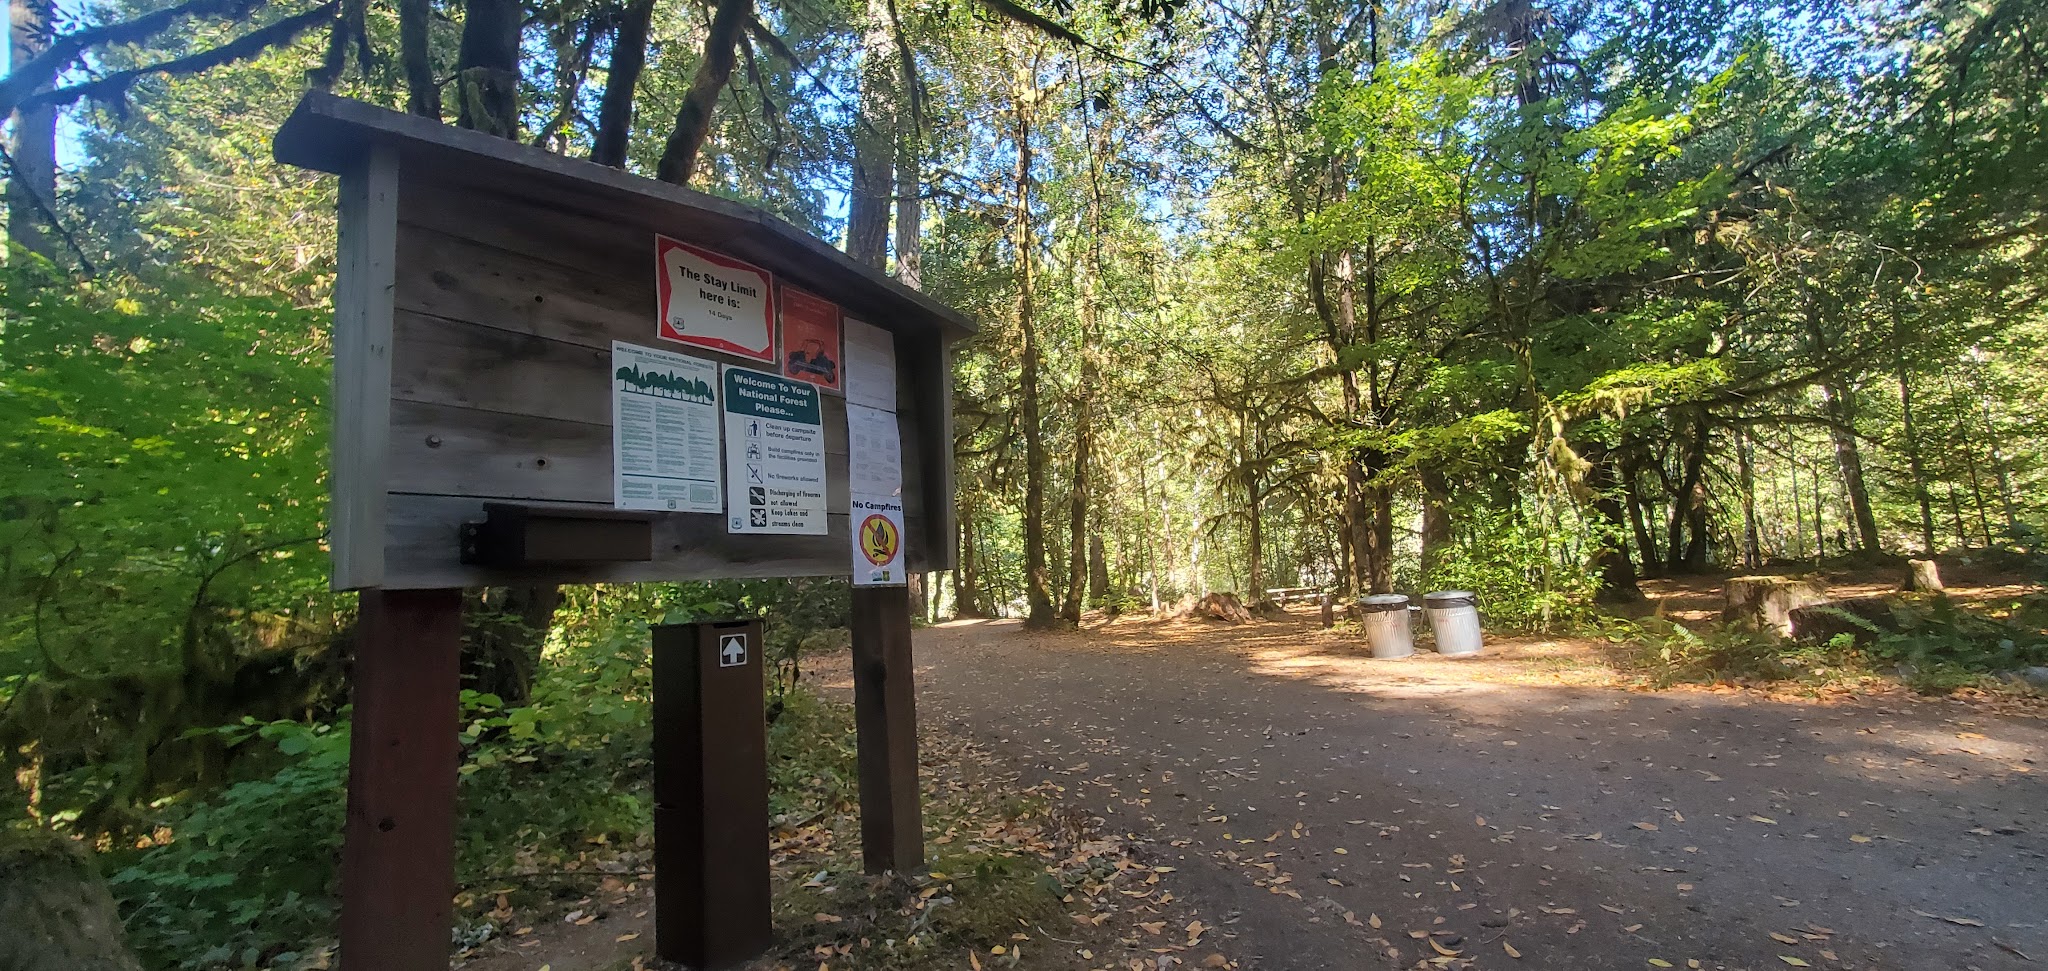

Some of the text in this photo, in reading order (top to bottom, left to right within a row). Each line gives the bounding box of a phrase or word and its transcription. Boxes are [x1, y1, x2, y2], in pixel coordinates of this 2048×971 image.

[679, 265, 757, 298] The Stay Limit
[699, 288, 740, 308] here is:
[708, 309, 733, 321] 14 Days
[616, 346, 643, 356] WELCOME
[733, 374, 811, 396] Welcome To Your
[738, 387, 808, 407] National Forest
[755, 402, 794, 417] Please...
[765, 422, 782, 430] Clean
[765, 430, 812, 442] before departure
[769, 488, 795, 498] Discharging
[852, 500, 902, 512] No Campfires
[770, 509, 783, 517] Keep
